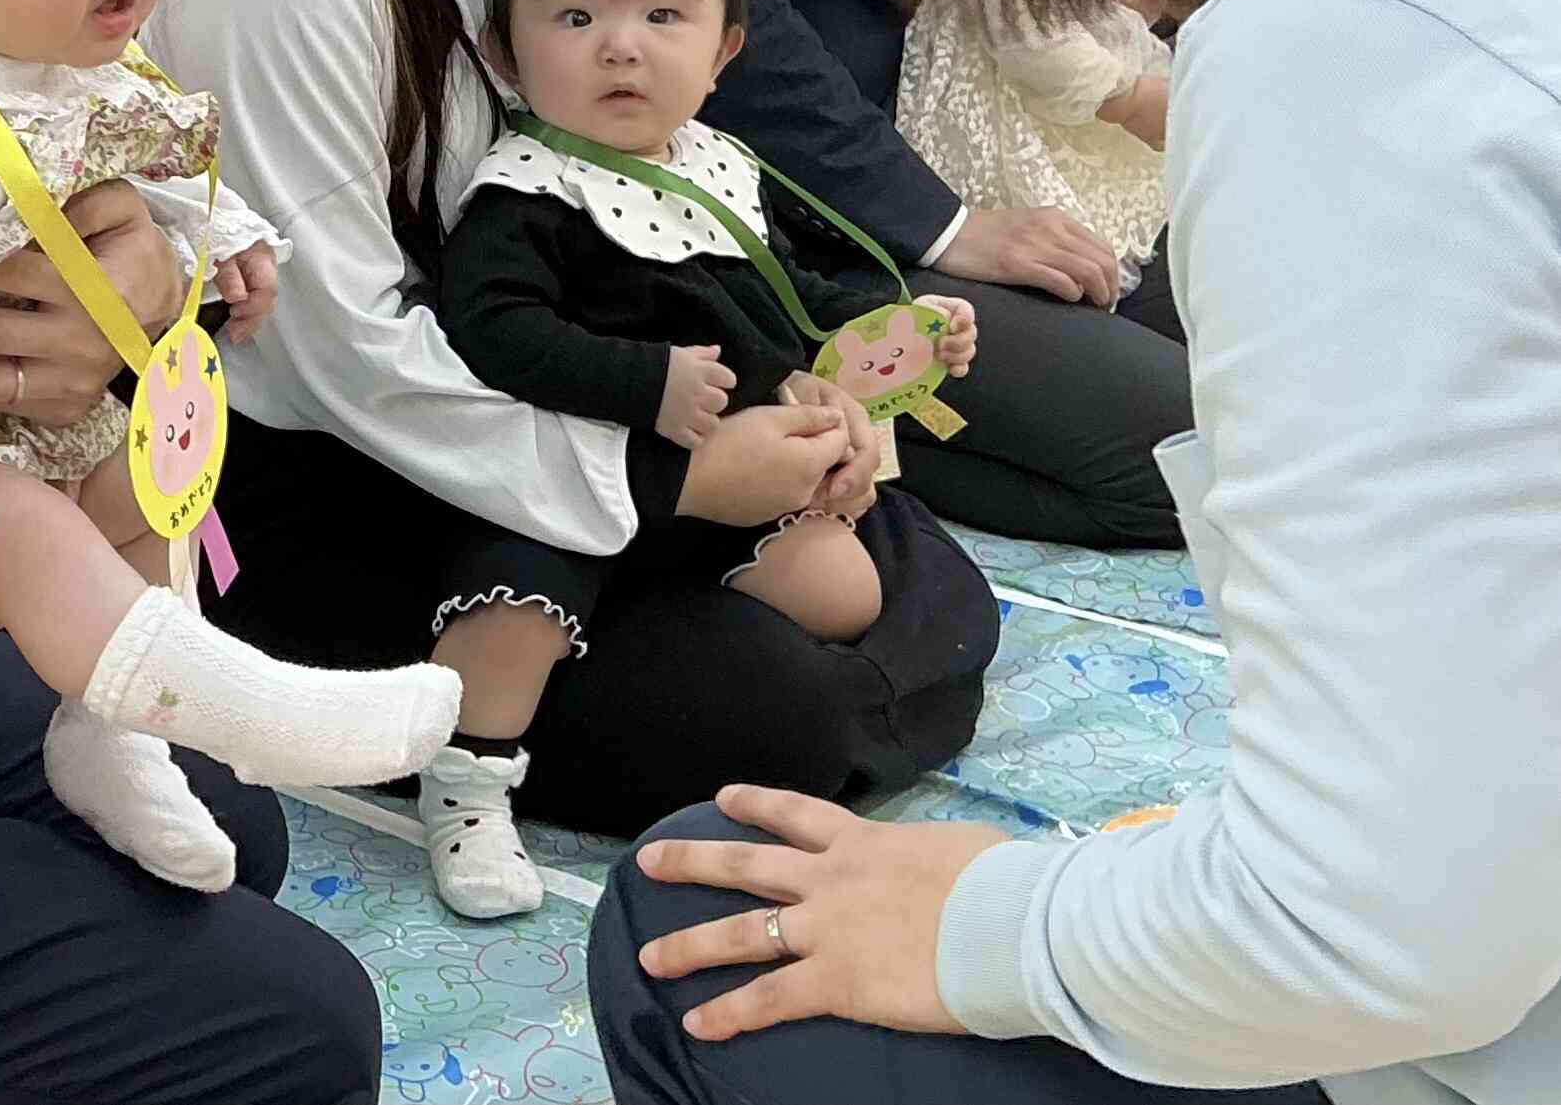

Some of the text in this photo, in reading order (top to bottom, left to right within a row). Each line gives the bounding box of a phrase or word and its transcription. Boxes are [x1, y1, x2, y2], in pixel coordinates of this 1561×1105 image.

[169, 471, 213, 529] おめでとう
